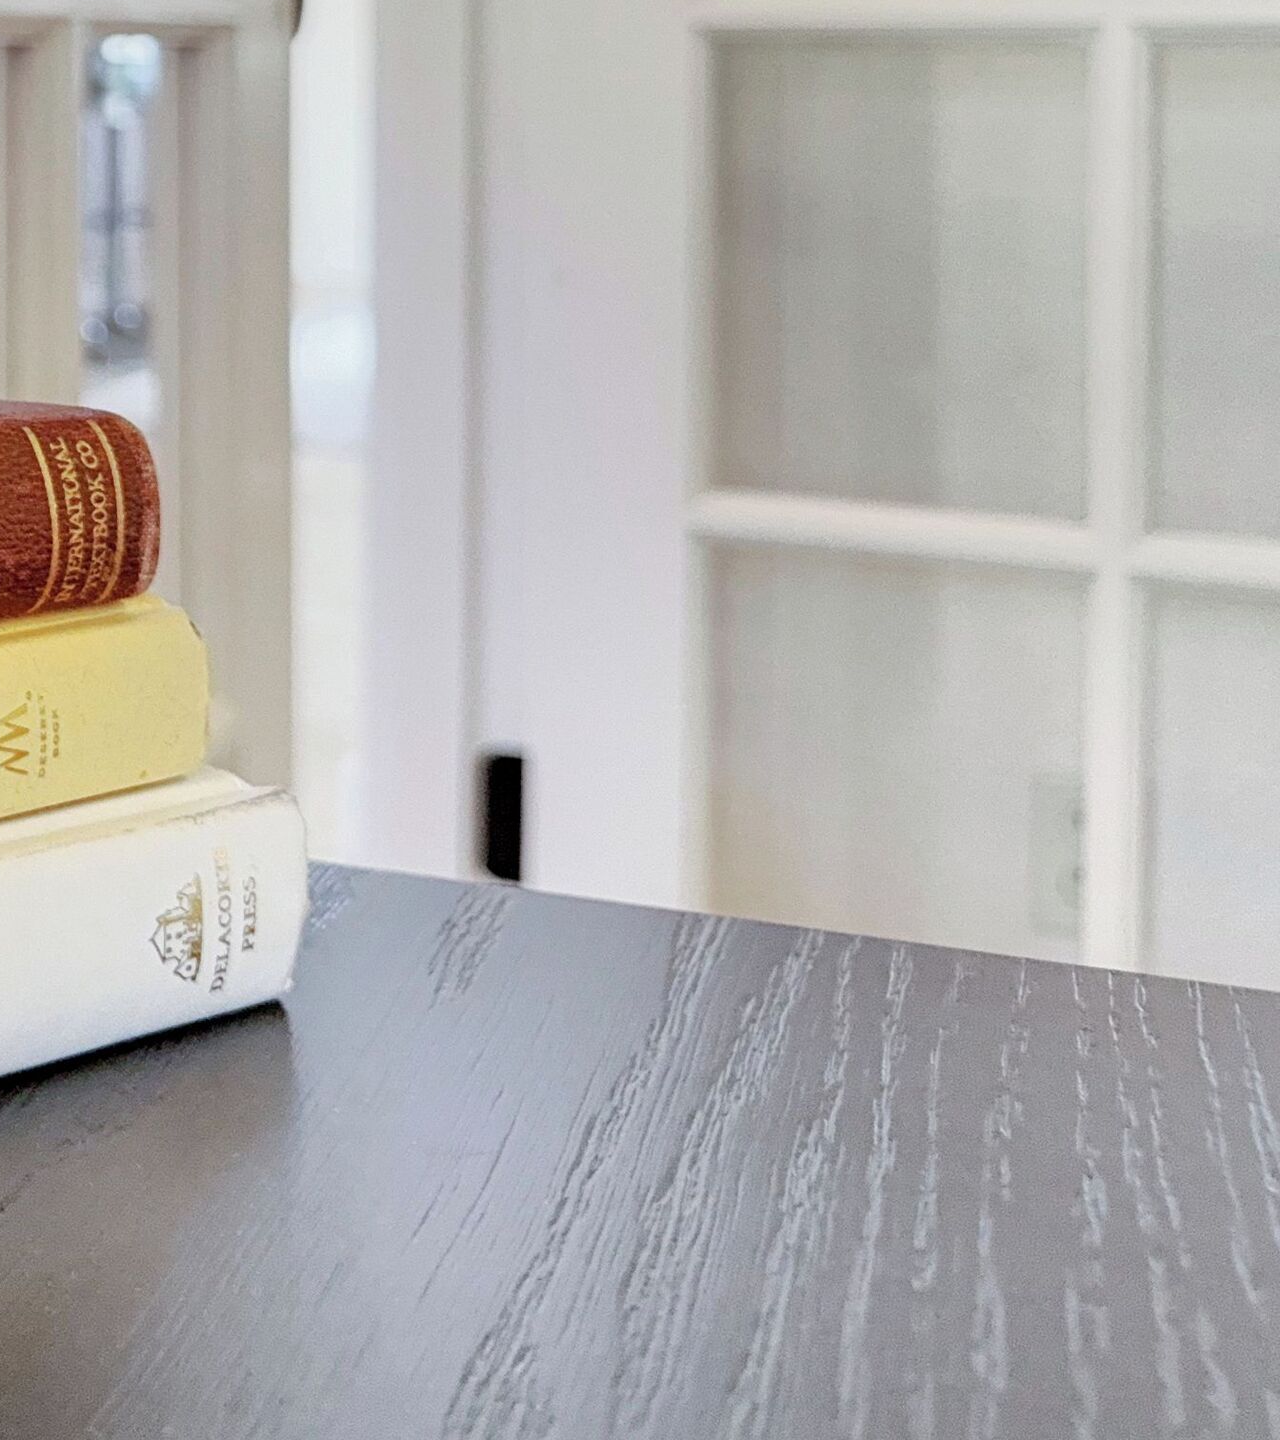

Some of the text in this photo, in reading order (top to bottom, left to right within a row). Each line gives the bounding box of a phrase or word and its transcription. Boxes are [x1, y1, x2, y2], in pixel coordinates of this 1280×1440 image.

[49, 435, 86, 603] INTERNATIONAL
[75, 439, 109, 600] TEXTBOOK CO
[51, 708, 60, 758] BOOK
[240, 876, 258, 952] PRESS
